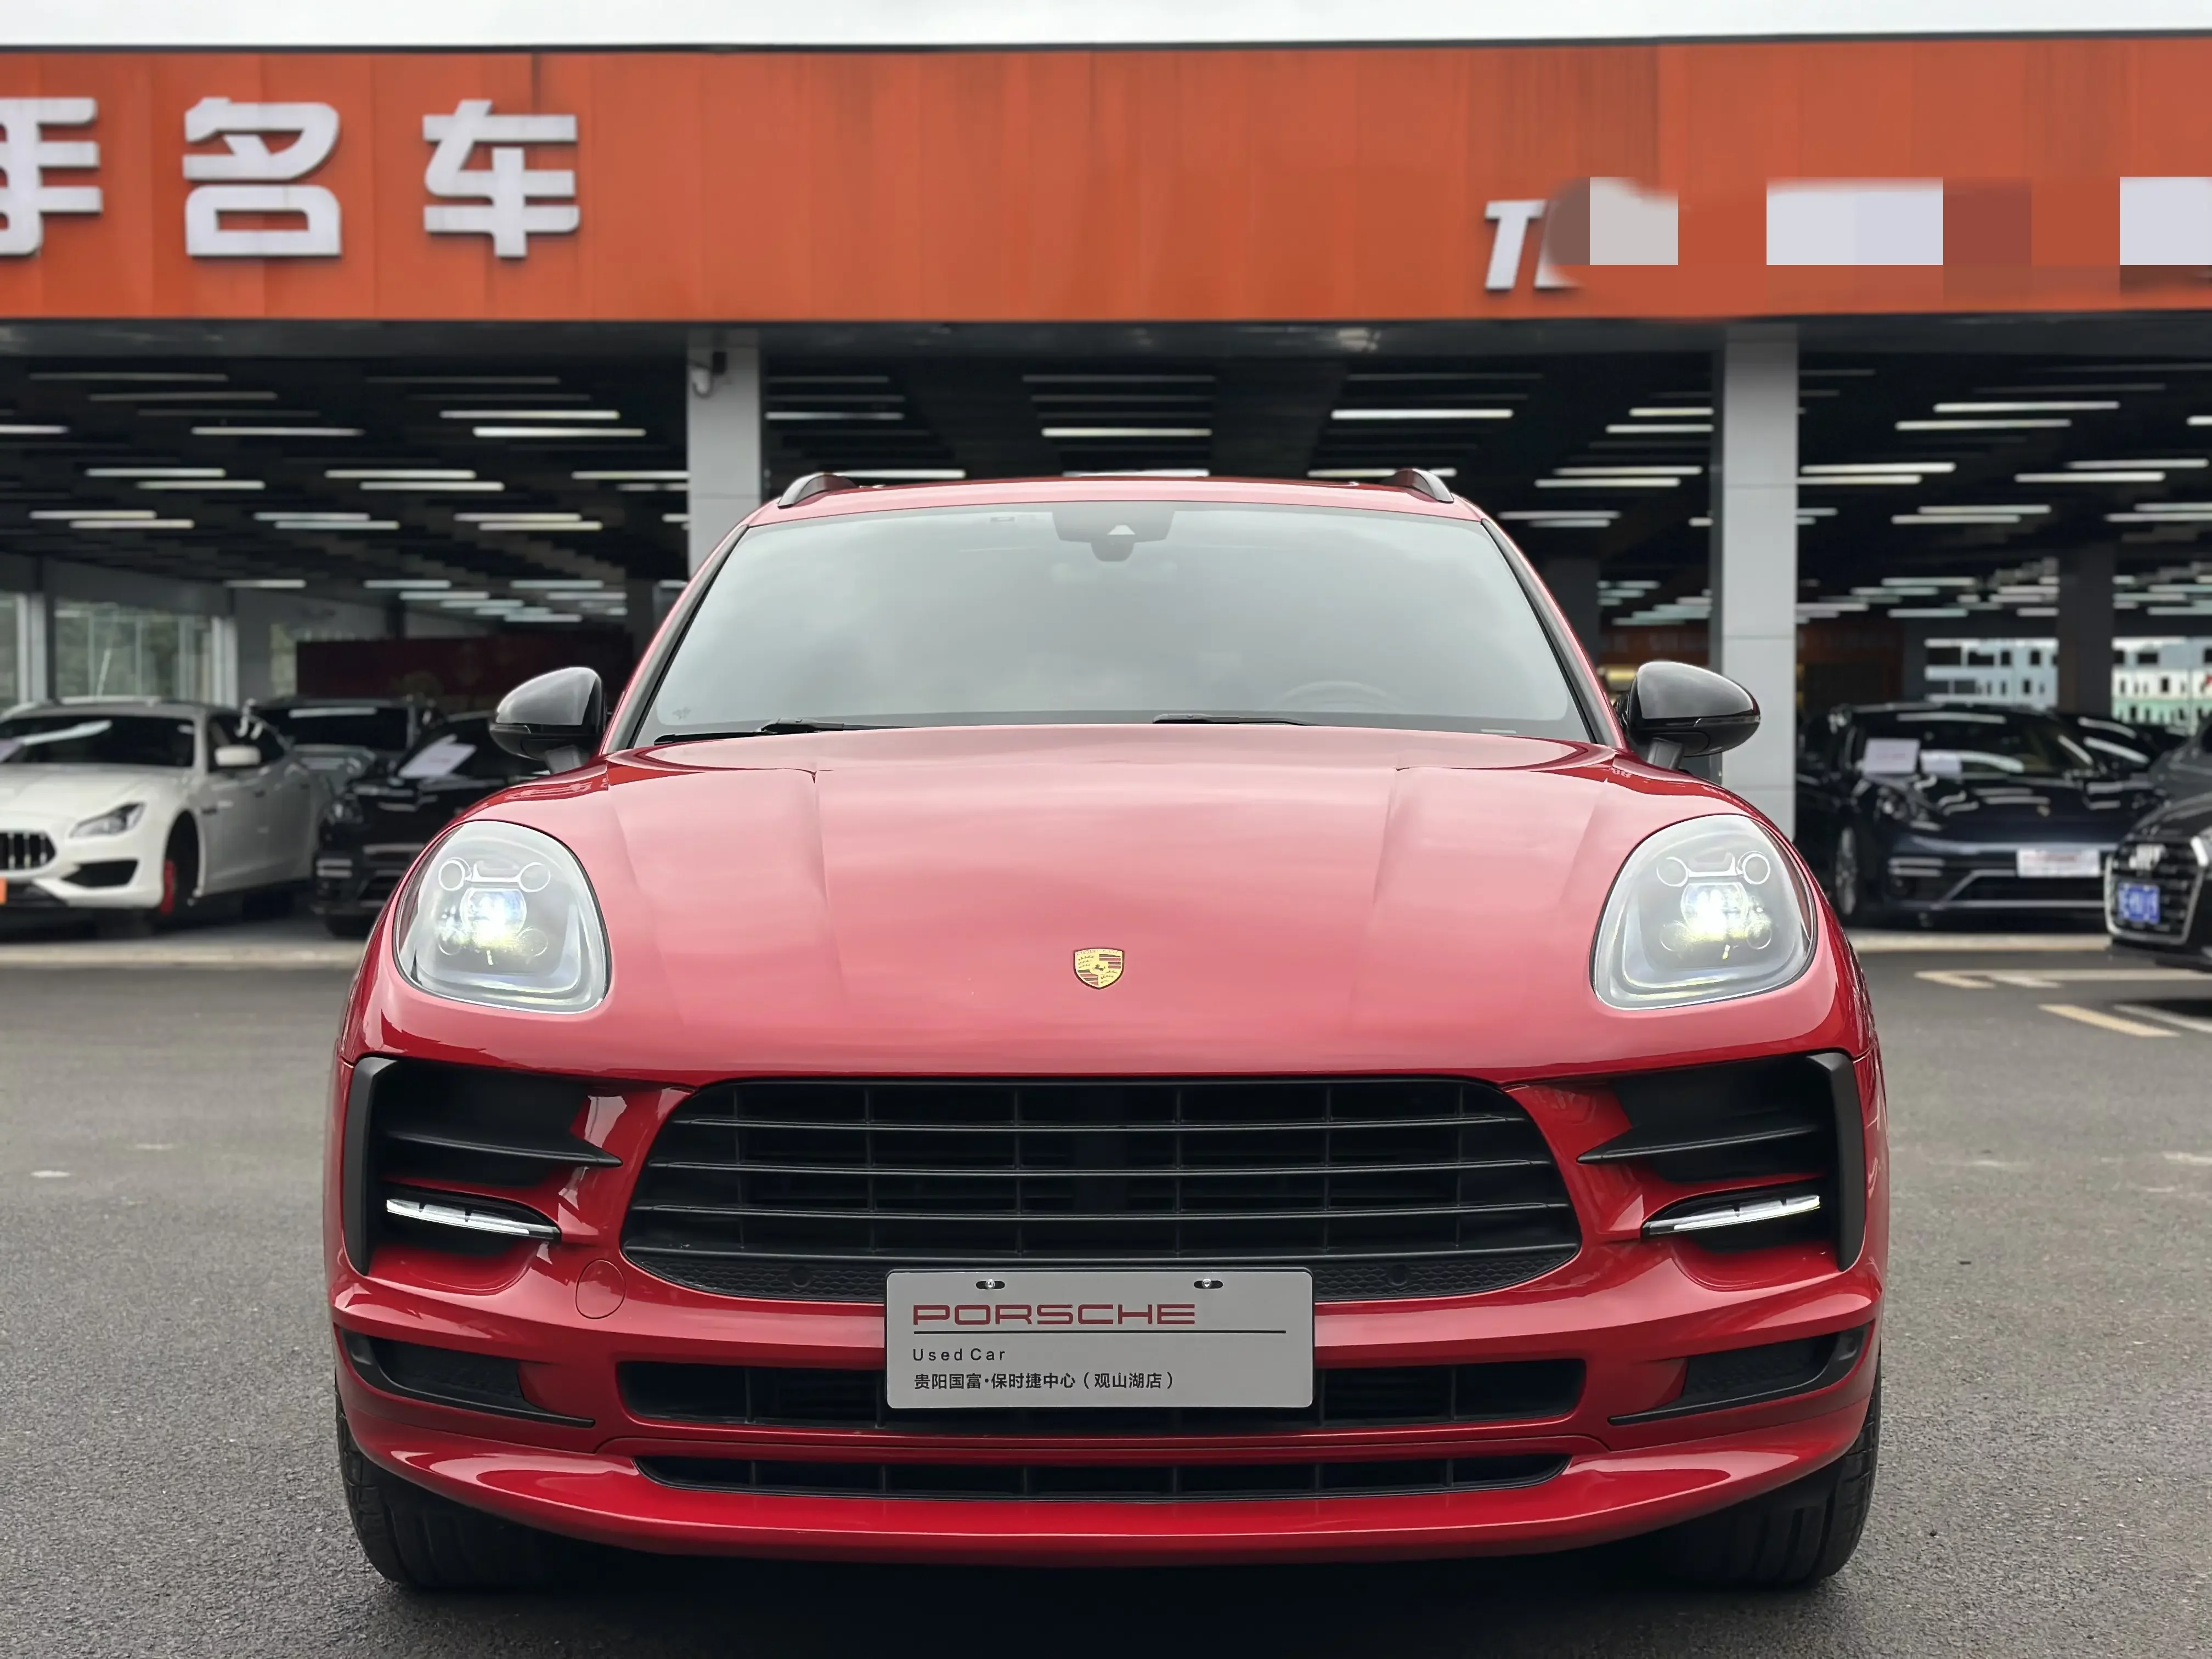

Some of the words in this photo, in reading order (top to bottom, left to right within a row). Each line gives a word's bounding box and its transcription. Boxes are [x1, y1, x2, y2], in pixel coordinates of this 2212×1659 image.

[0, 97, 580, 257] 手名车
[913, 1304, 1195, 1325] PORSCHE
[912, 1348, 963, 1361] Used
[970, 1347, 1006, 1361] Car
